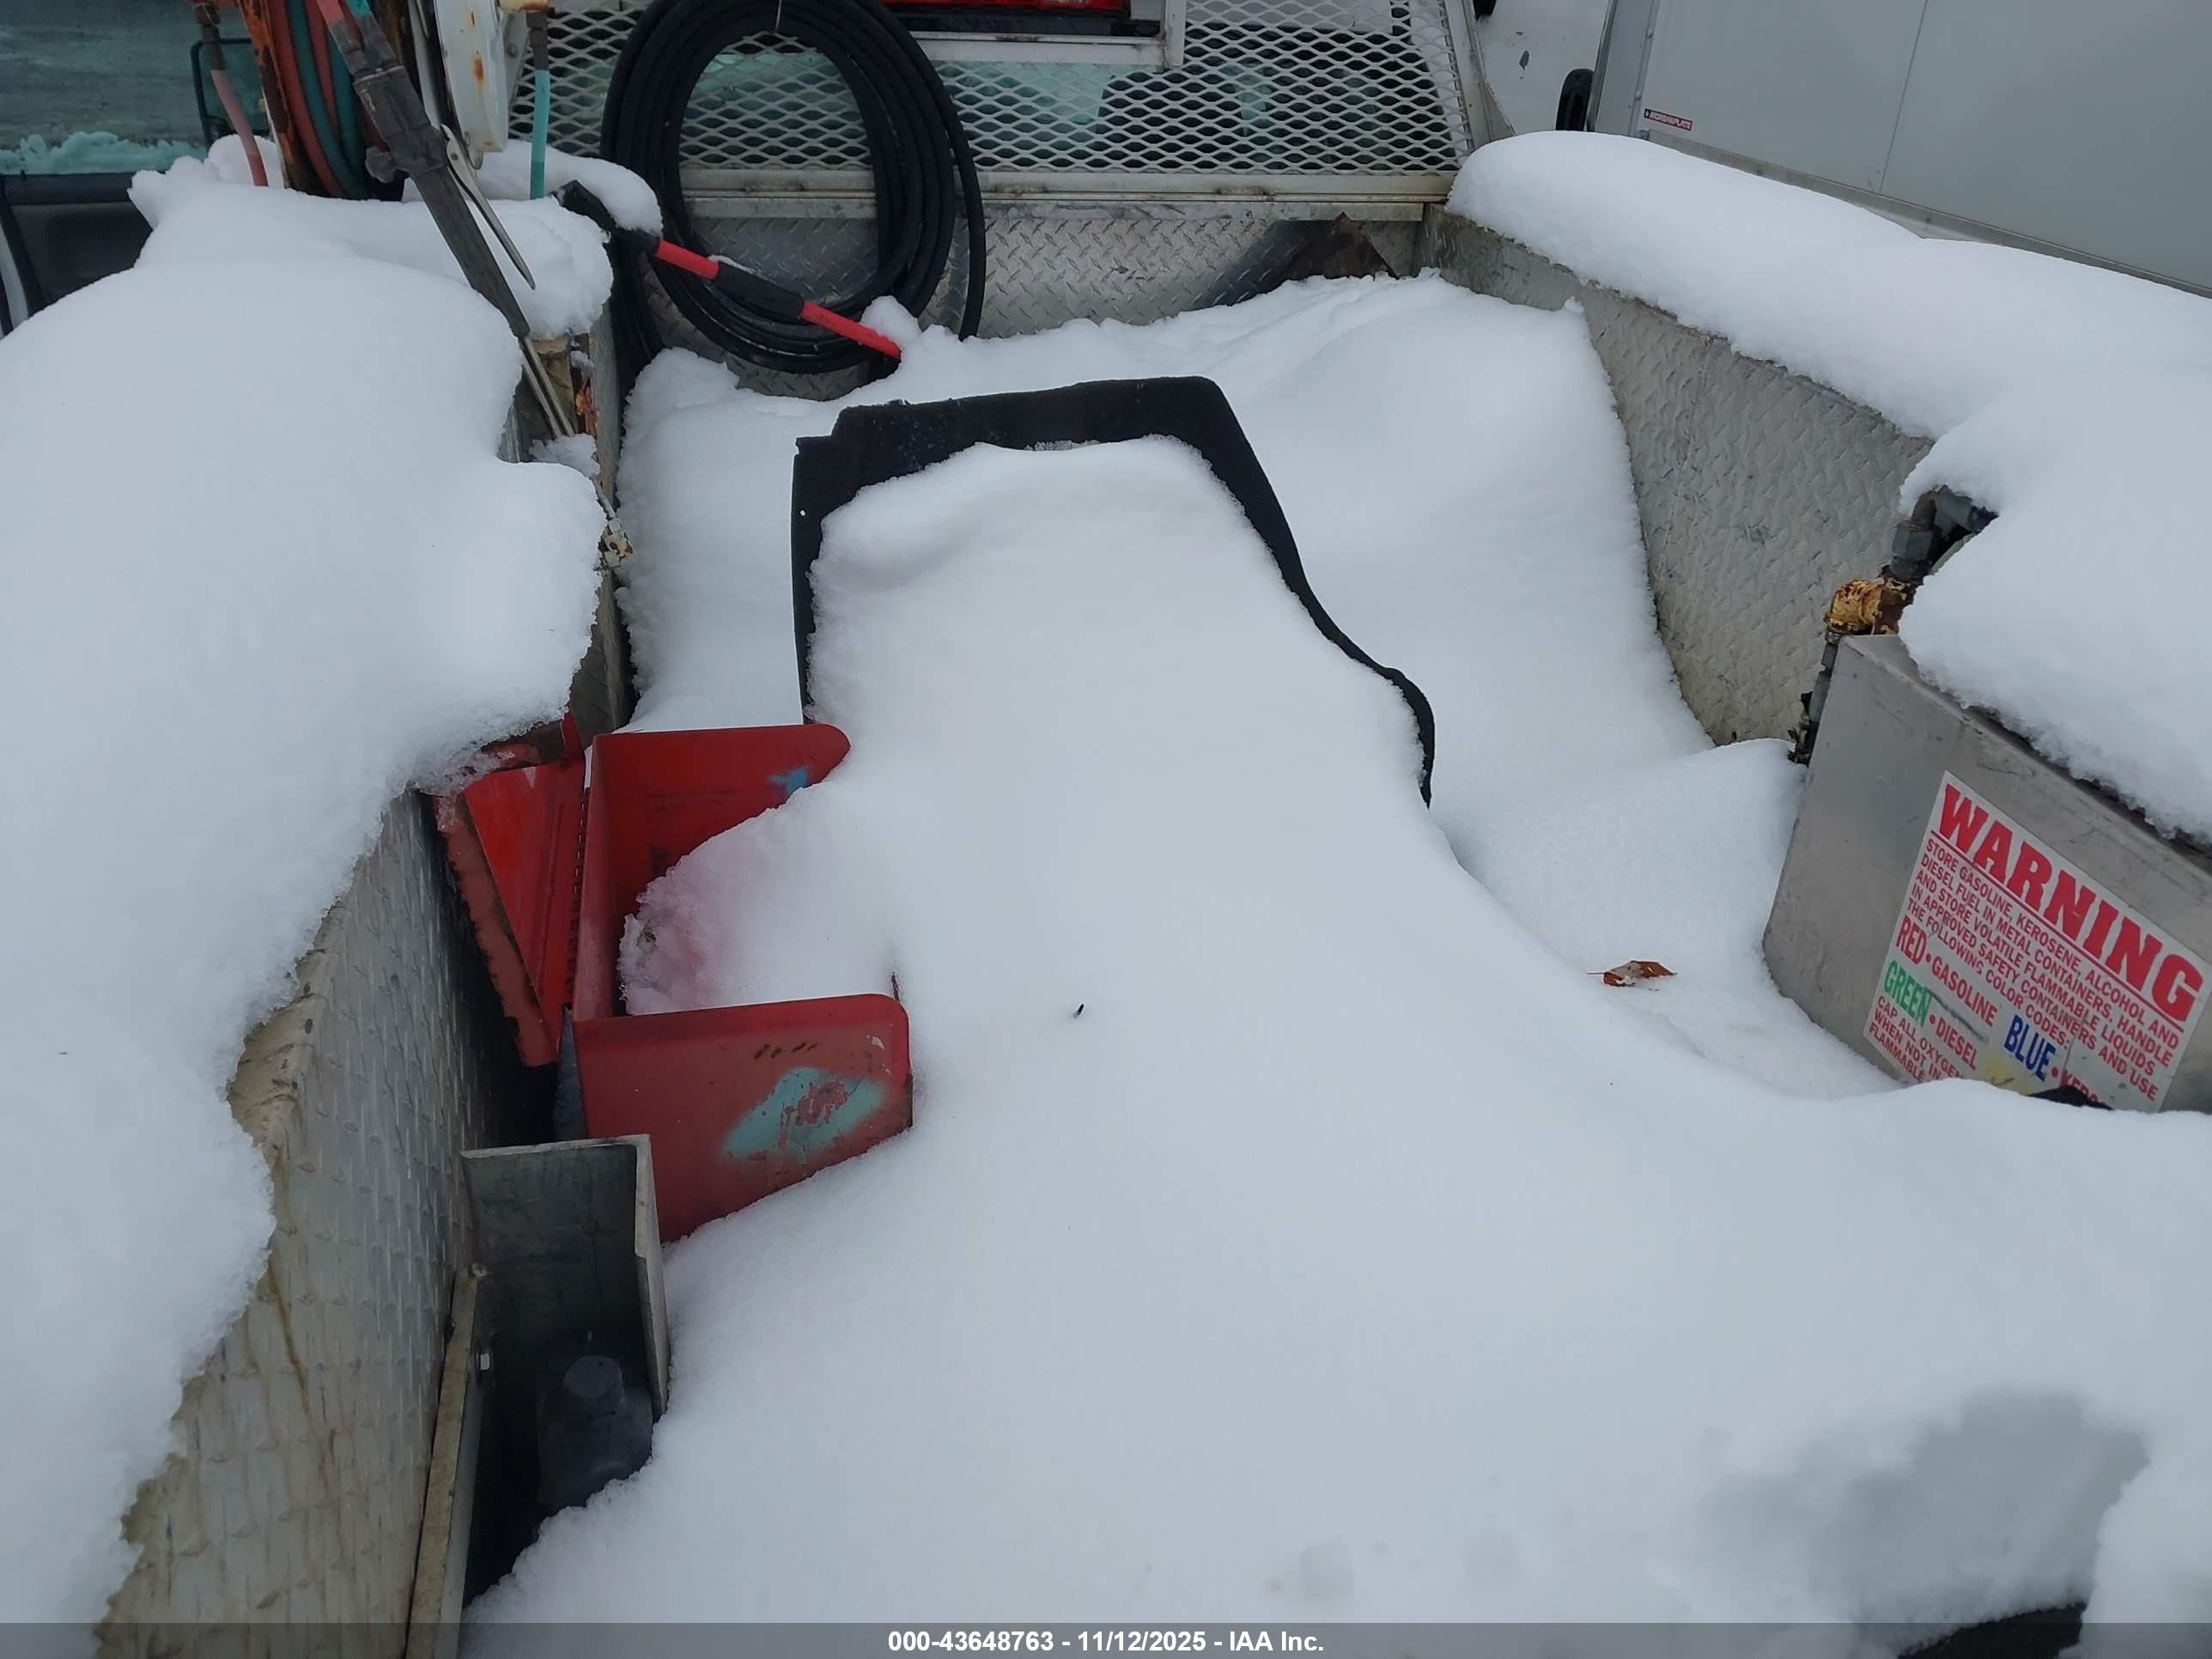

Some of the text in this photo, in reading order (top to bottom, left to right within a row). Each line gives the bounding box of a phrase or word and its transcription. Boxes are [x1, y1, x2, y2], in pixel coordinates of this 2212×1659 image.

[1922, 854, 2171, 1067] DIESEL FUEL IN METAL CONTAINERS. HANDLE
[1926, 839, 2178, 1050] STORE GASOLINE, KEROSENE, ALCOHOL AND
[1940, 783, 2203, 1022] WARNING
[1878, 996, 1896, 1019] CAP
[1899, 1018, 1916, 1041] ALL
[1884, 960, 1978, 1070] GREEN DIESEL
[1896, 915, 1996, 1026] RED GASOLINE
[1907, 899, 2069, 1049] THE FOLLOWING COLOR CODES:
[1912, 885, 2156, 1100] IN APPROVED SAFETY CONTAINERS AND USE
[1917, 871, 2154, 1076] AND STORE VOLATILE FLAMMABLE LIQUIDS
[1869, 1023, 1923, 1080] FLAMMABLE
[1874, 1010, 1939, 1081] WHEN NOT IN
[2004, 1015, 2055, 1081] BLUE
